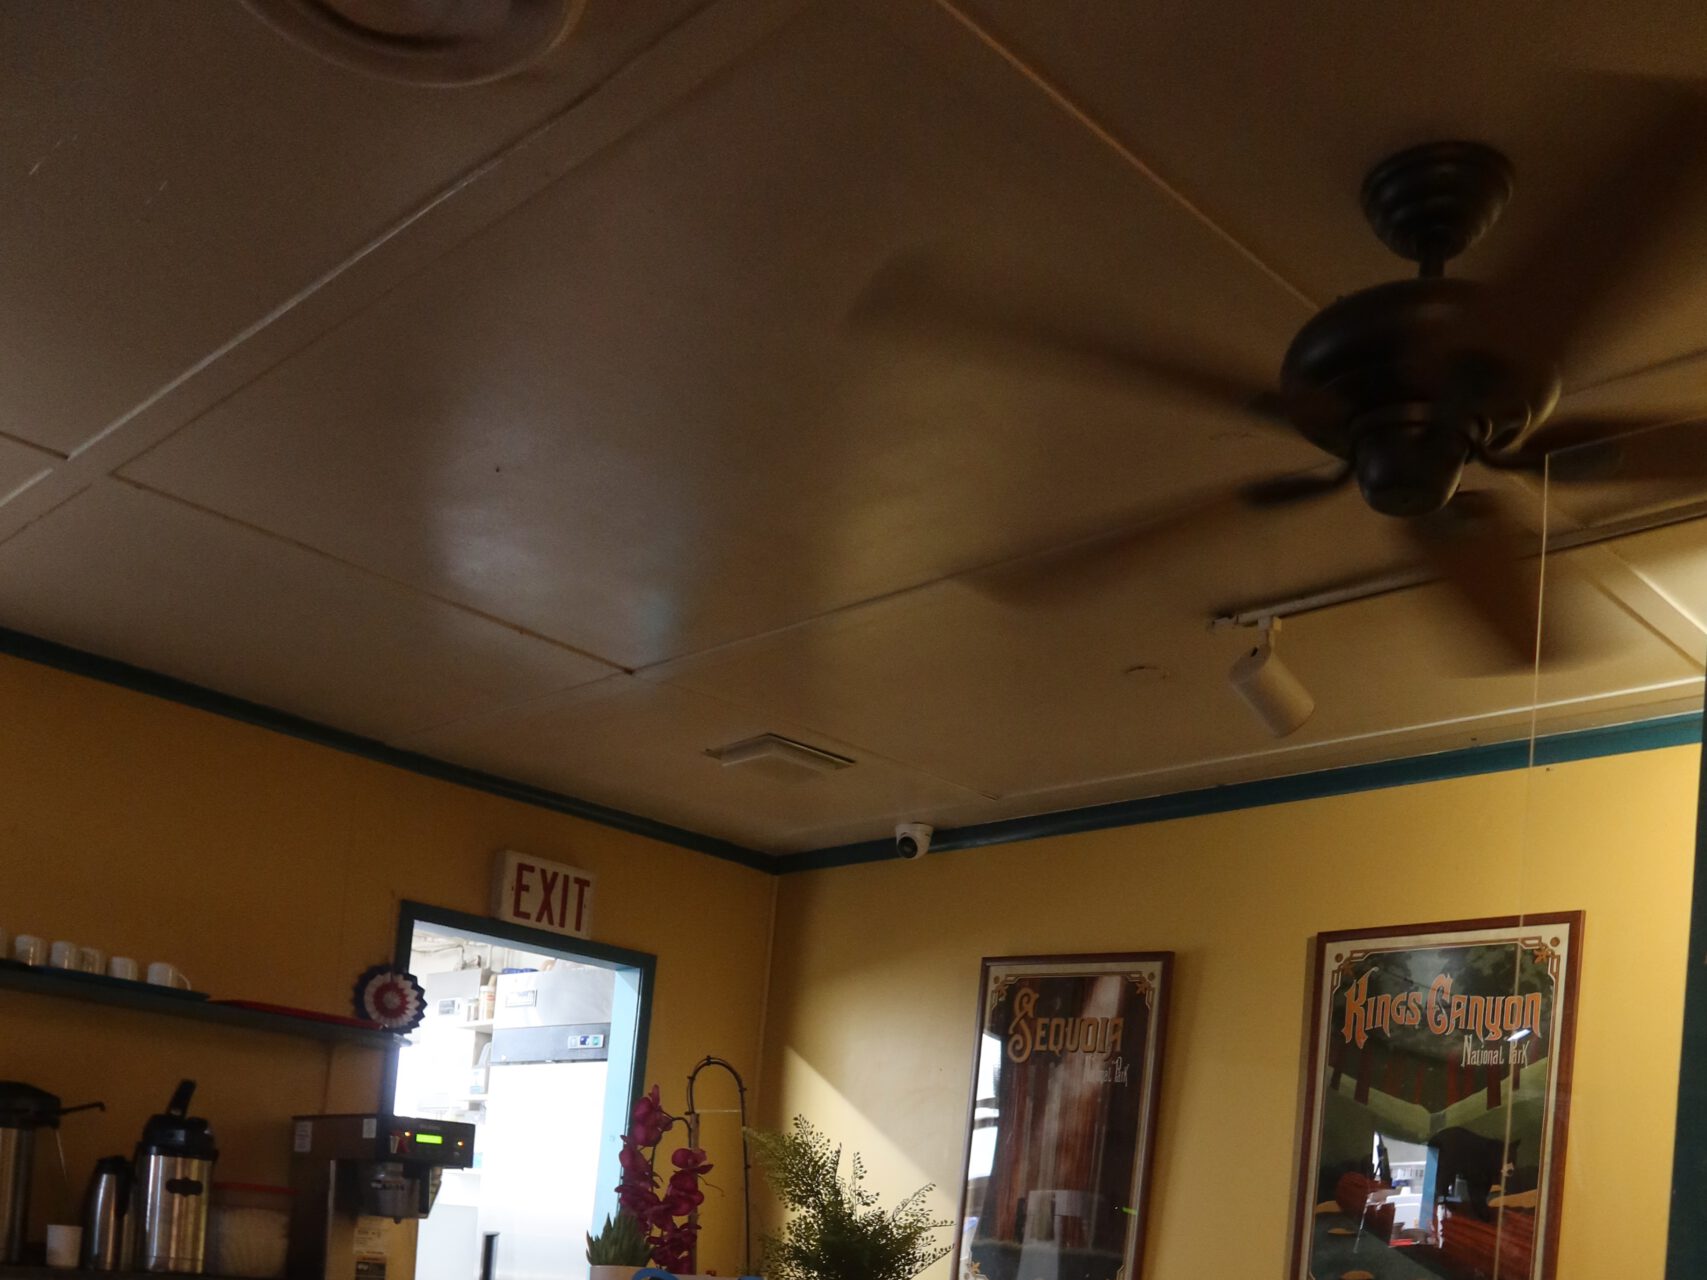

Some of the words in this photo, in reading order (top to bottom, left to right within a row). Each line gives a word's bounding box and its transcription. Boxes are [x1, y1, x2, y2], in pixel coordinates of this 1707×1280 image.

[513, 862, 590, 931] EXIT
[1007, 986, 1124, 1064] SEQUOIA
[1461, 1034, 1504, 1068] National
